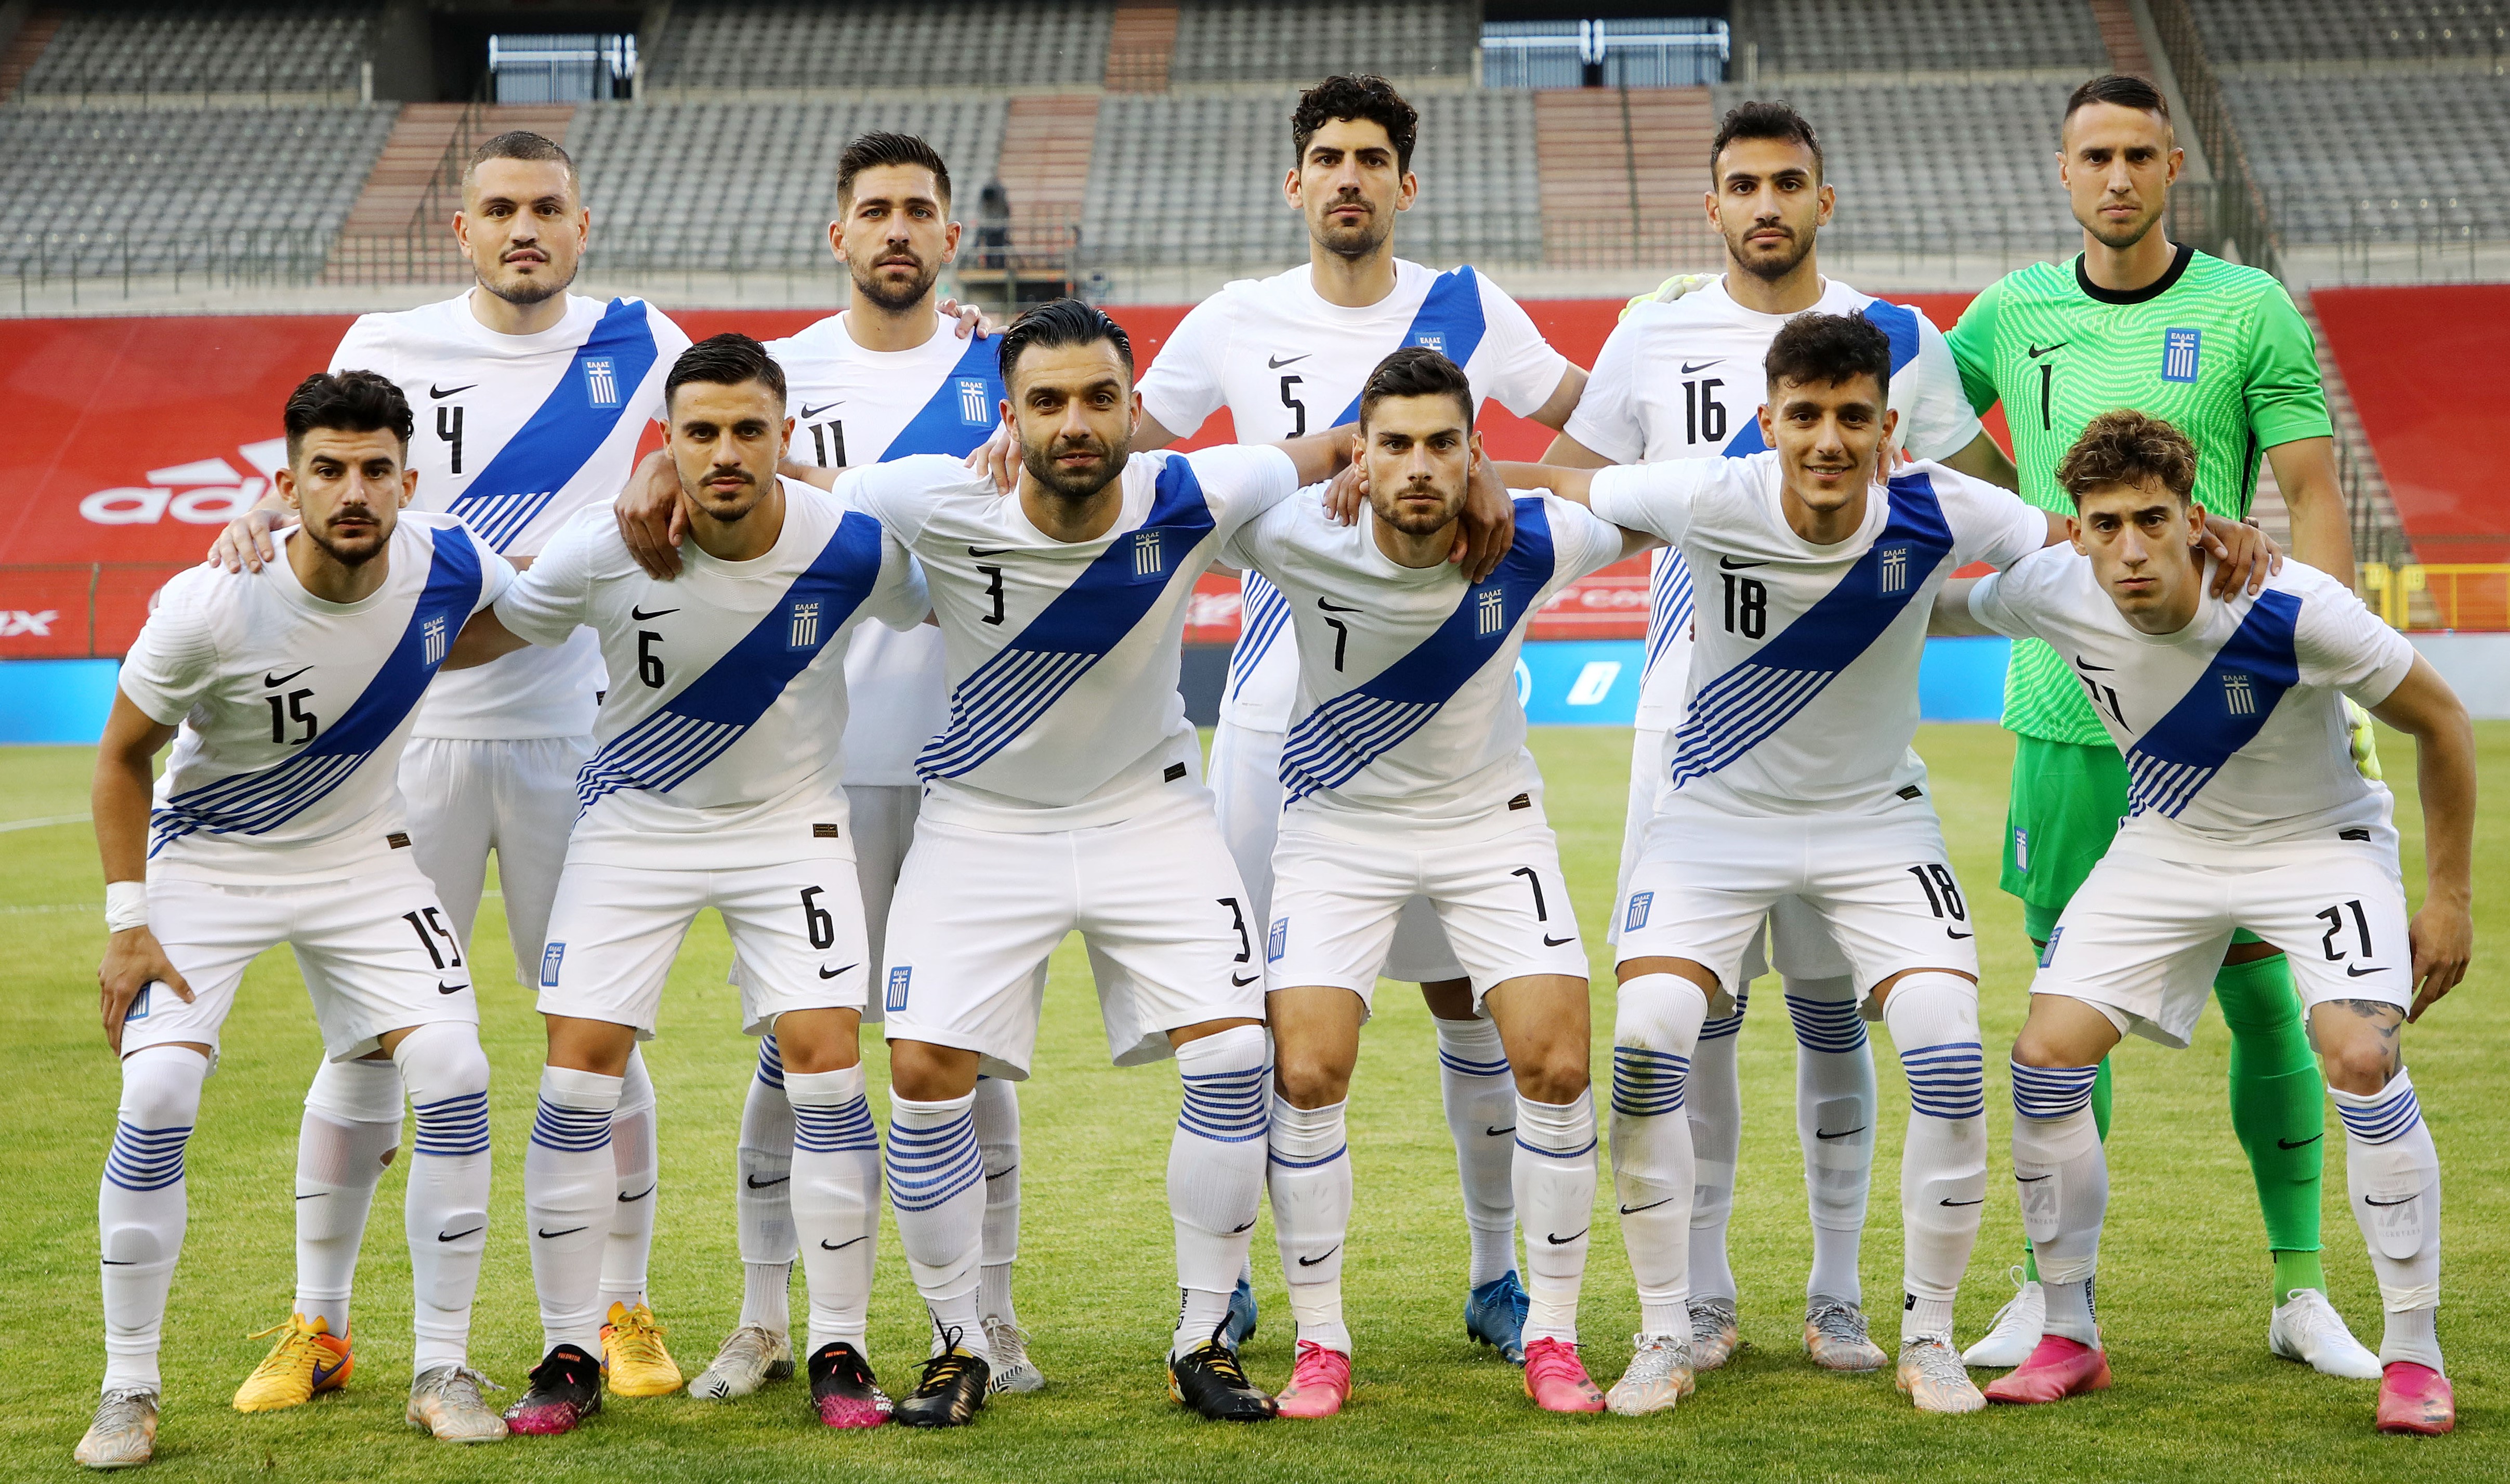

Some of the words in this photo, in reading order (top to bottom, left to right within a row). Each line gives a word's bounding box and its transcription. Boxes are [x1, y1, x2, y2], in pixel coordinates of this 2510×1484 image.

[1280, 375, 1305, 440] 5
[1681, 378, 1726, 444] 16
[2039, 364, 2052, 431] 1
[437, 406, 463, 474] 4
[808, 420, 847, 467] 11
[976, 565, 1004, 626] 3
[1719, 572, 1767, 640] 18
[638, 629, 665, 689] 6
[1323, 616, 1348, 673] 7
[265, 688, 318, 745] 15
[800, 885, 834, 950] 6
[1510, 866, 1547, 922] 7
[1907, 864, 1965, 922] 18
[402, 907, 462, 969] 15
[1216, 897, 1251, 963] 3
[2315, 899, 2372, 961] 21
